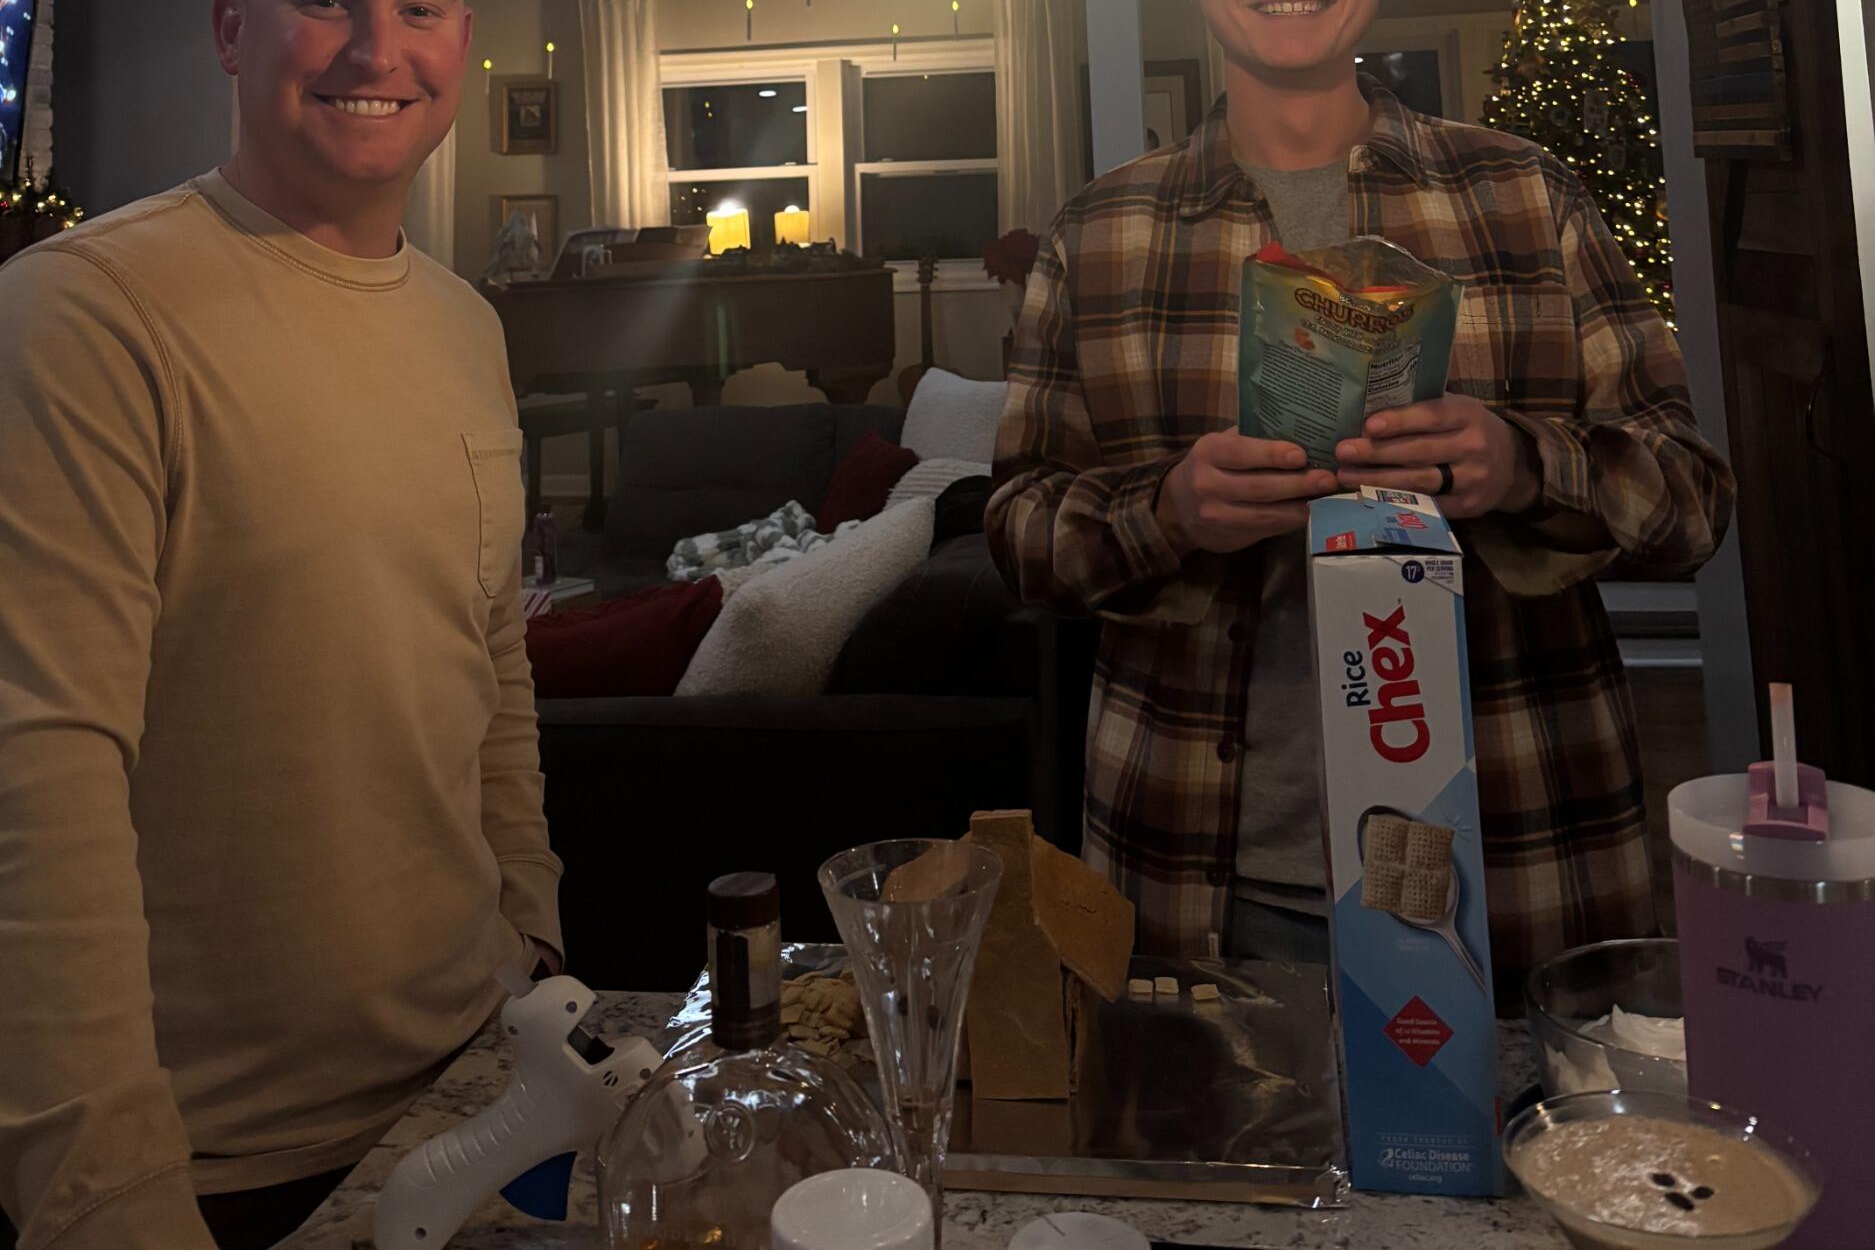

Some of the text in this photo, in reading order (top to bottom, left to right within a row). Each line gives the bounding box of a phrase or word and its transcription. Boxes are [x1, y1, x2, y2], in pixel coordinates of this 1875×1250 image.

[1341, 650, 1371, 708] Rice
[1362, 605, 1431, 764] Chex
[1715, 966, 1825, 1001] STANLEY
[1394, 1148, 1471, 1161] Celiac Disease
[1395, 1160, 1471, 1173] FOUNDATION
